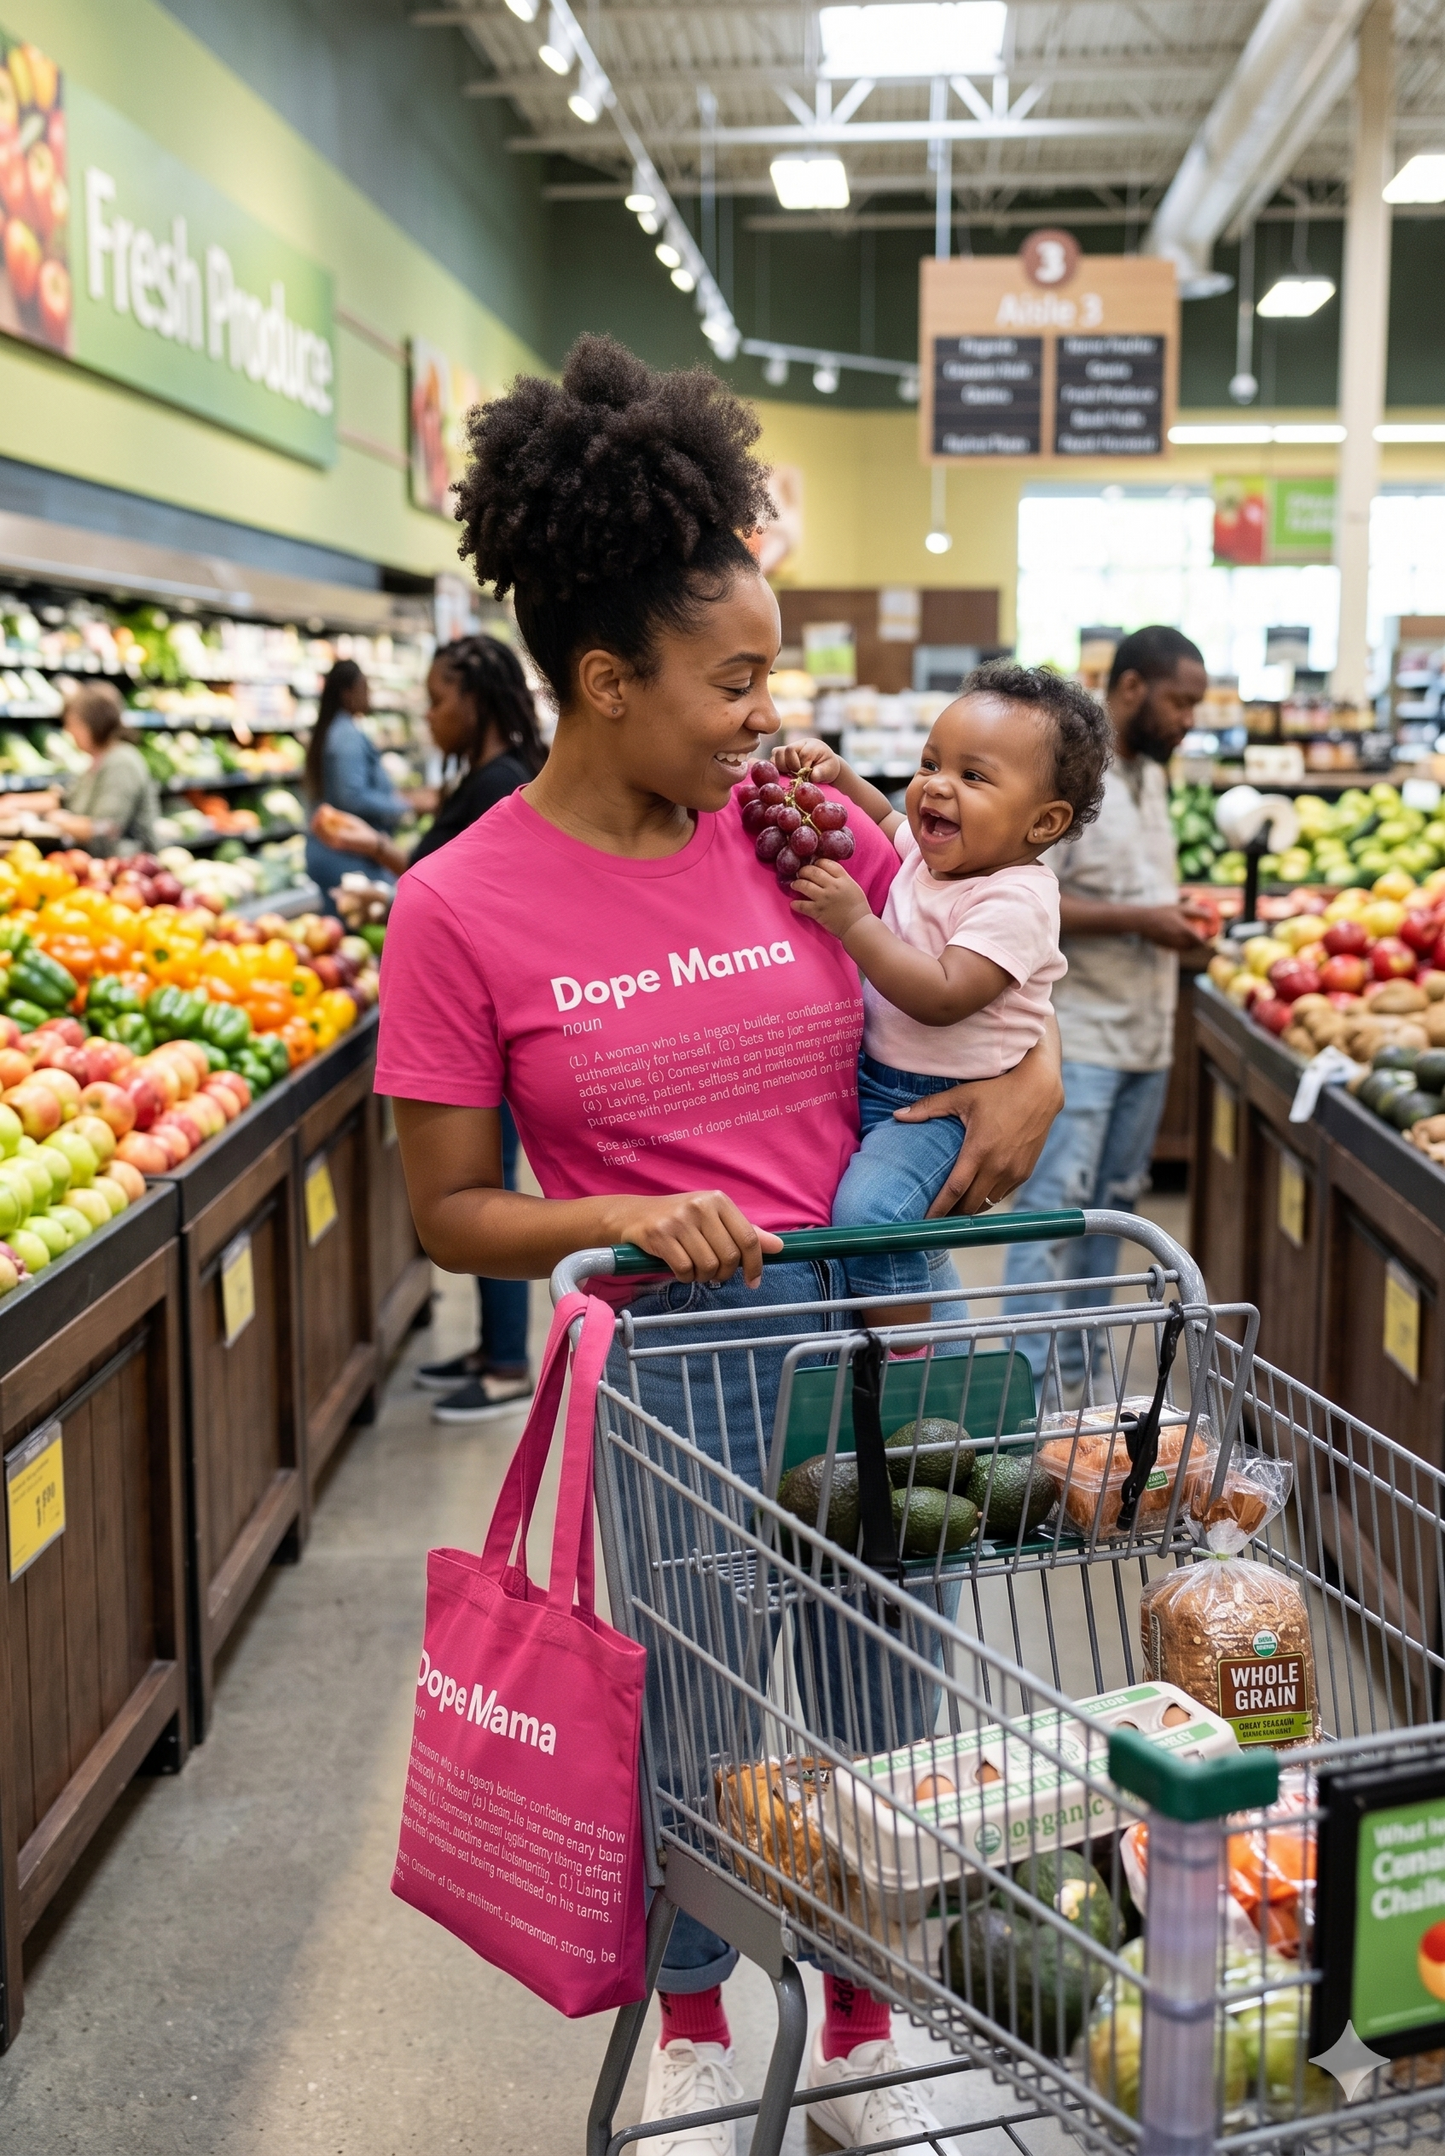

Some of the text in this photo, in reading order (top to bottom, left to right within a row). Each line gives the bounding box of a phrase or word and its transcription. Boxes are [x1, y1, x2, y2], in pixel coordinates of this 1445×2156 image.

[1036, 240, 1066, 283] 3
[84, 165, 334, 418] Fresh Produce
[996, 293, 1102, 326] Aisle 3
[551, 940, 796, 1012] Dope Mama
[563, 1018, 602, 1036] noun
[594, 1052, 604, 1063] A
[606, 1042, 649, 1060] woman
[651, 1036, 677, 1049] who
[693, 1031, 701, 1041] a
[653, 1054, 670, 1066] for
[767, 1028, 784, 1040] the
[742, 1063, 761, 1077] and
[579, 1084, 607, 1098] adds
[637, 1104, 662, 1118] with
[710, 1088, 730, 1102] and
[731, 1080, 760, 1095] doing
[820, 1064, 833, 1075] on
[693, 1123, 704, 1136] of
[706, 1119, 732, 1133] dope
[1230, 1662, 1299, 1688] WHOLE
[1235, 1685, 1296, 1710] GRAIN
[467, 1683, 556, 1755] Mama
[574, 1818, 594, 1836] and
[596, 1824, 625, 1844] show
[546, 1891, 557, 1906] on
[559, 1893, 574, 1913] his
[601, 1948, 616, 1963] be
